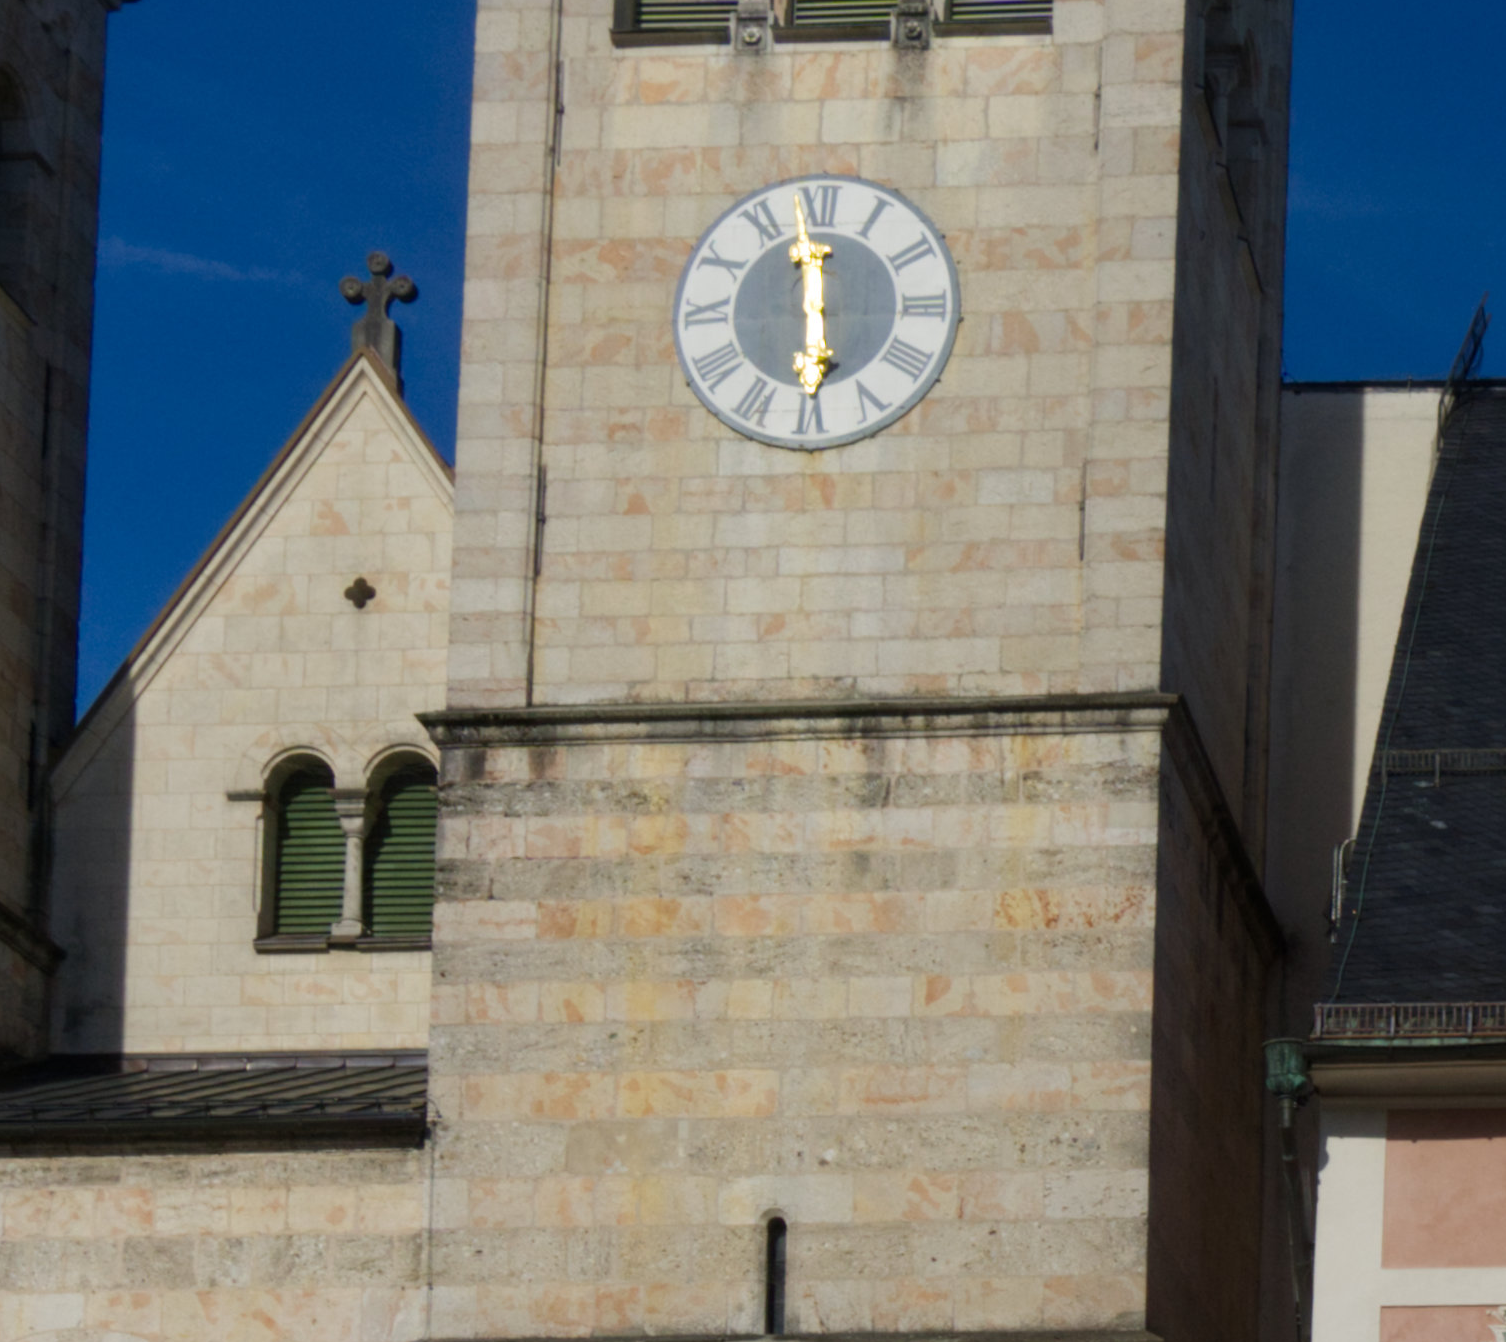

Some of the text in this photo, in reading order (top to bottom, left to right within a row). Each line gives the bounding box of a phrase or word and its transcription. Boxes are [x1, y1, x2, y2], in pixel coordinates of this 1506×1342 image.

[737, 197, 786, 249] XI
[798, 185, 842, 228] XII
[855, 195, 895, 241] I
[697, 240, 750, 283] X
[886, 231, 937, 276] II
[684, 295, 731, 331] IX
[901, 289, 947, 322] III
[691, 339, 744, 395] VIII
[879, 335, 934, 384] IIII
[731, 375, 778, 429] VII
[791, 392, 829, 435] VI
[855, 379, 893, 425] V
